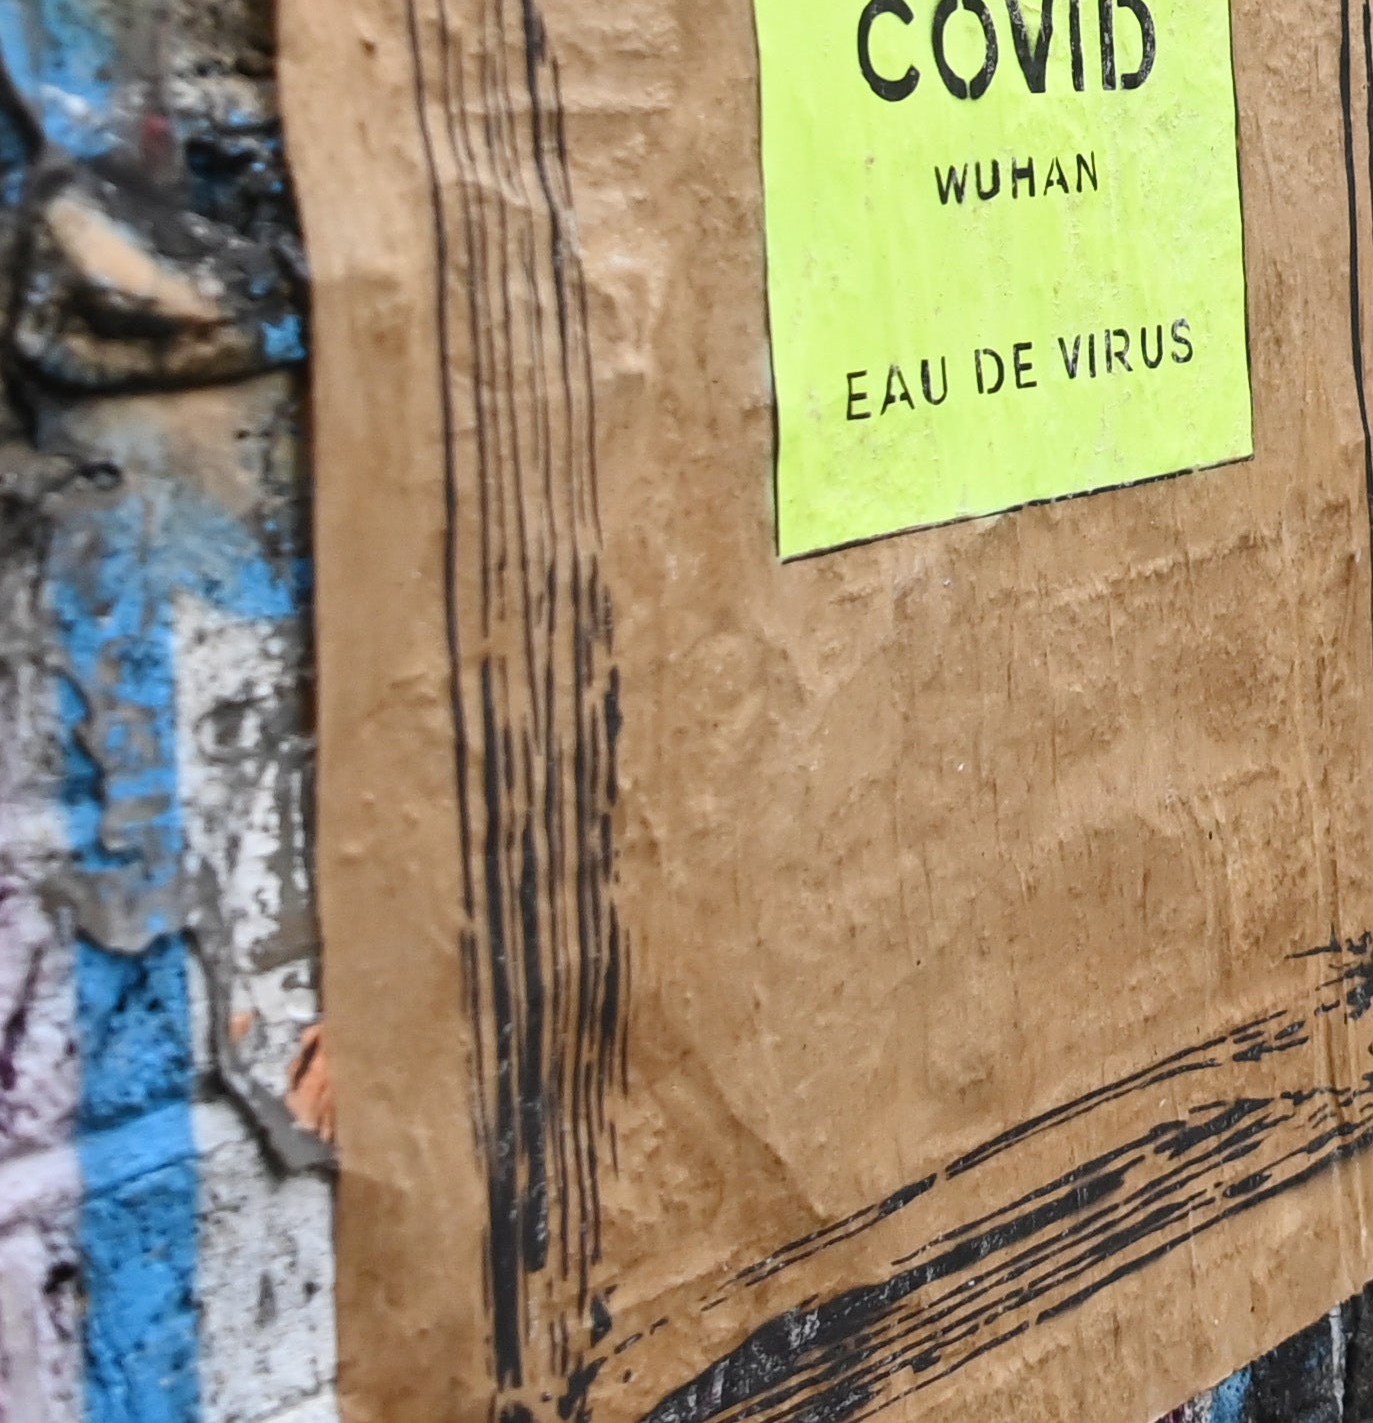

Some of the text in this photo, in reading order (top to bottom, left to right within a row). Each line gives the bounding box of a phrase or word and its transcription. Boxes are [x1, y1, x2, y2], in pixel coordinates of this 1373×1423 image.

[934, 151, 1100, 206] WUHAN
[845, 318, 1195, 422] EAU DE VIRUS
